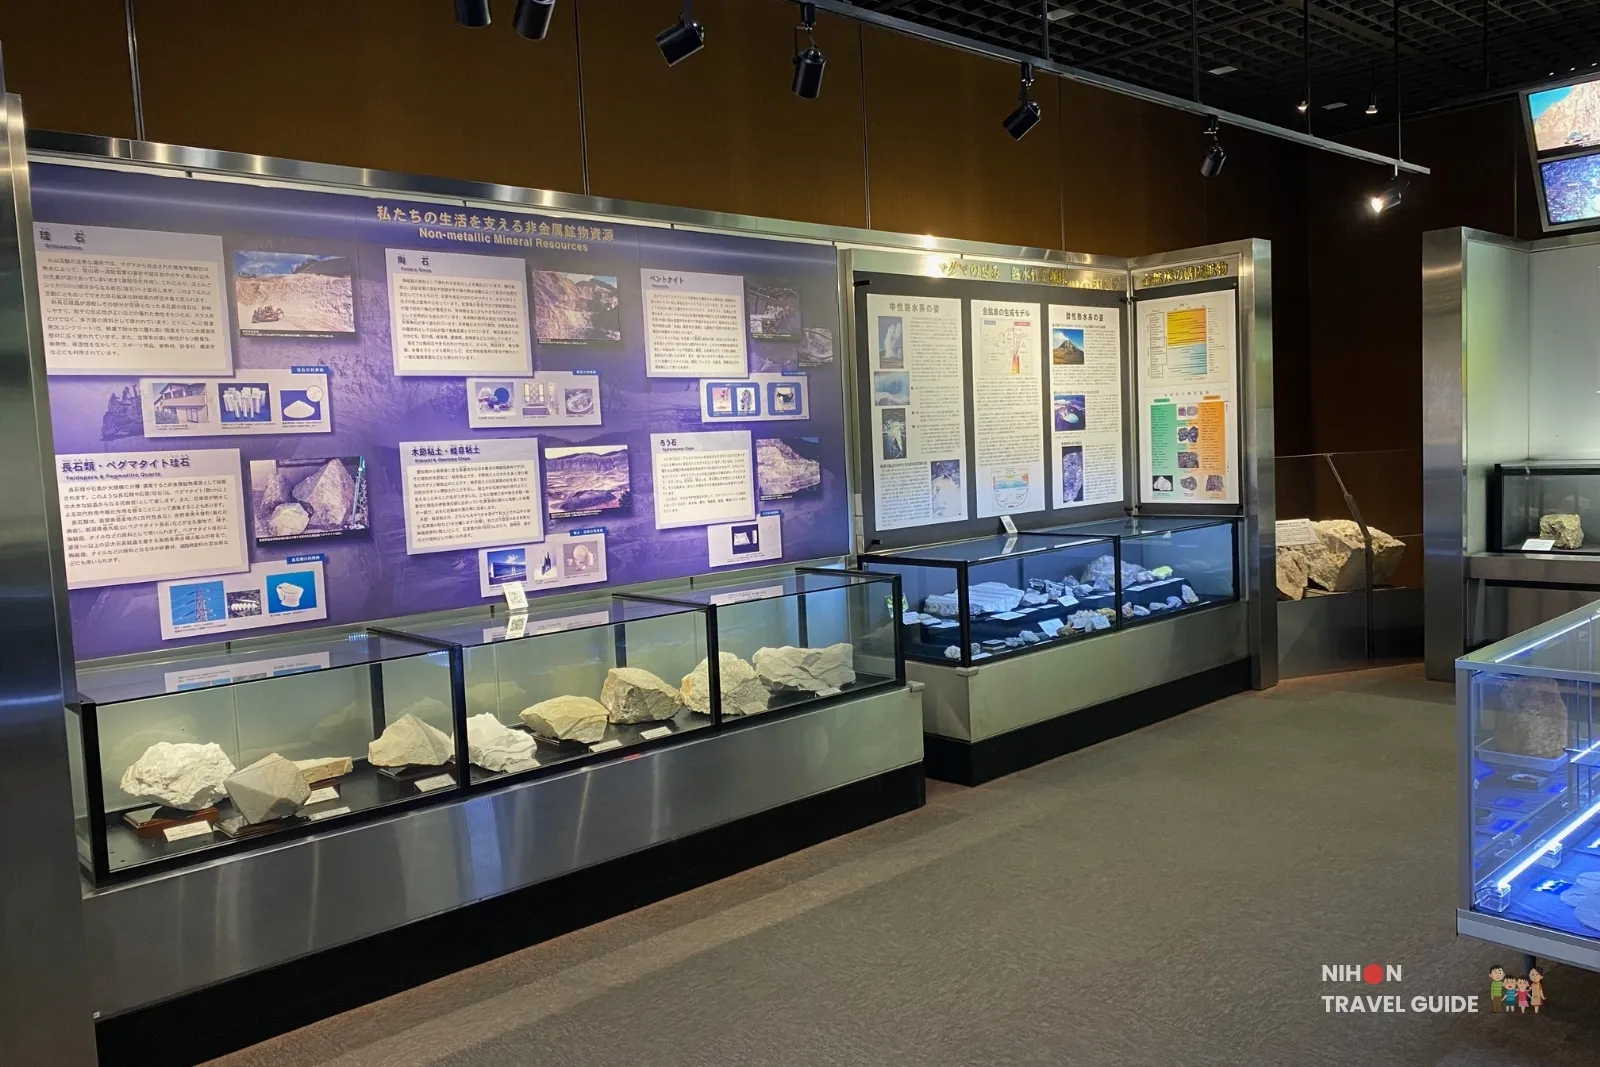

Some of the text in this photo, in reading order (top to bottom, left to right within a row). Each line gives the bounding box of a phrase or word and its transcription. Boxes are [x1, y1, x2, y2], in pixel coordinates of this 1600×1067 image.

[376, 205, 614, 242] 私たちの生活を支える非金属鉱物資源
[419, 228, 588, 252] Non-metallic Mineral Resources
[61, 456, 190, 472] 長石類・ペグマタイト珪石
